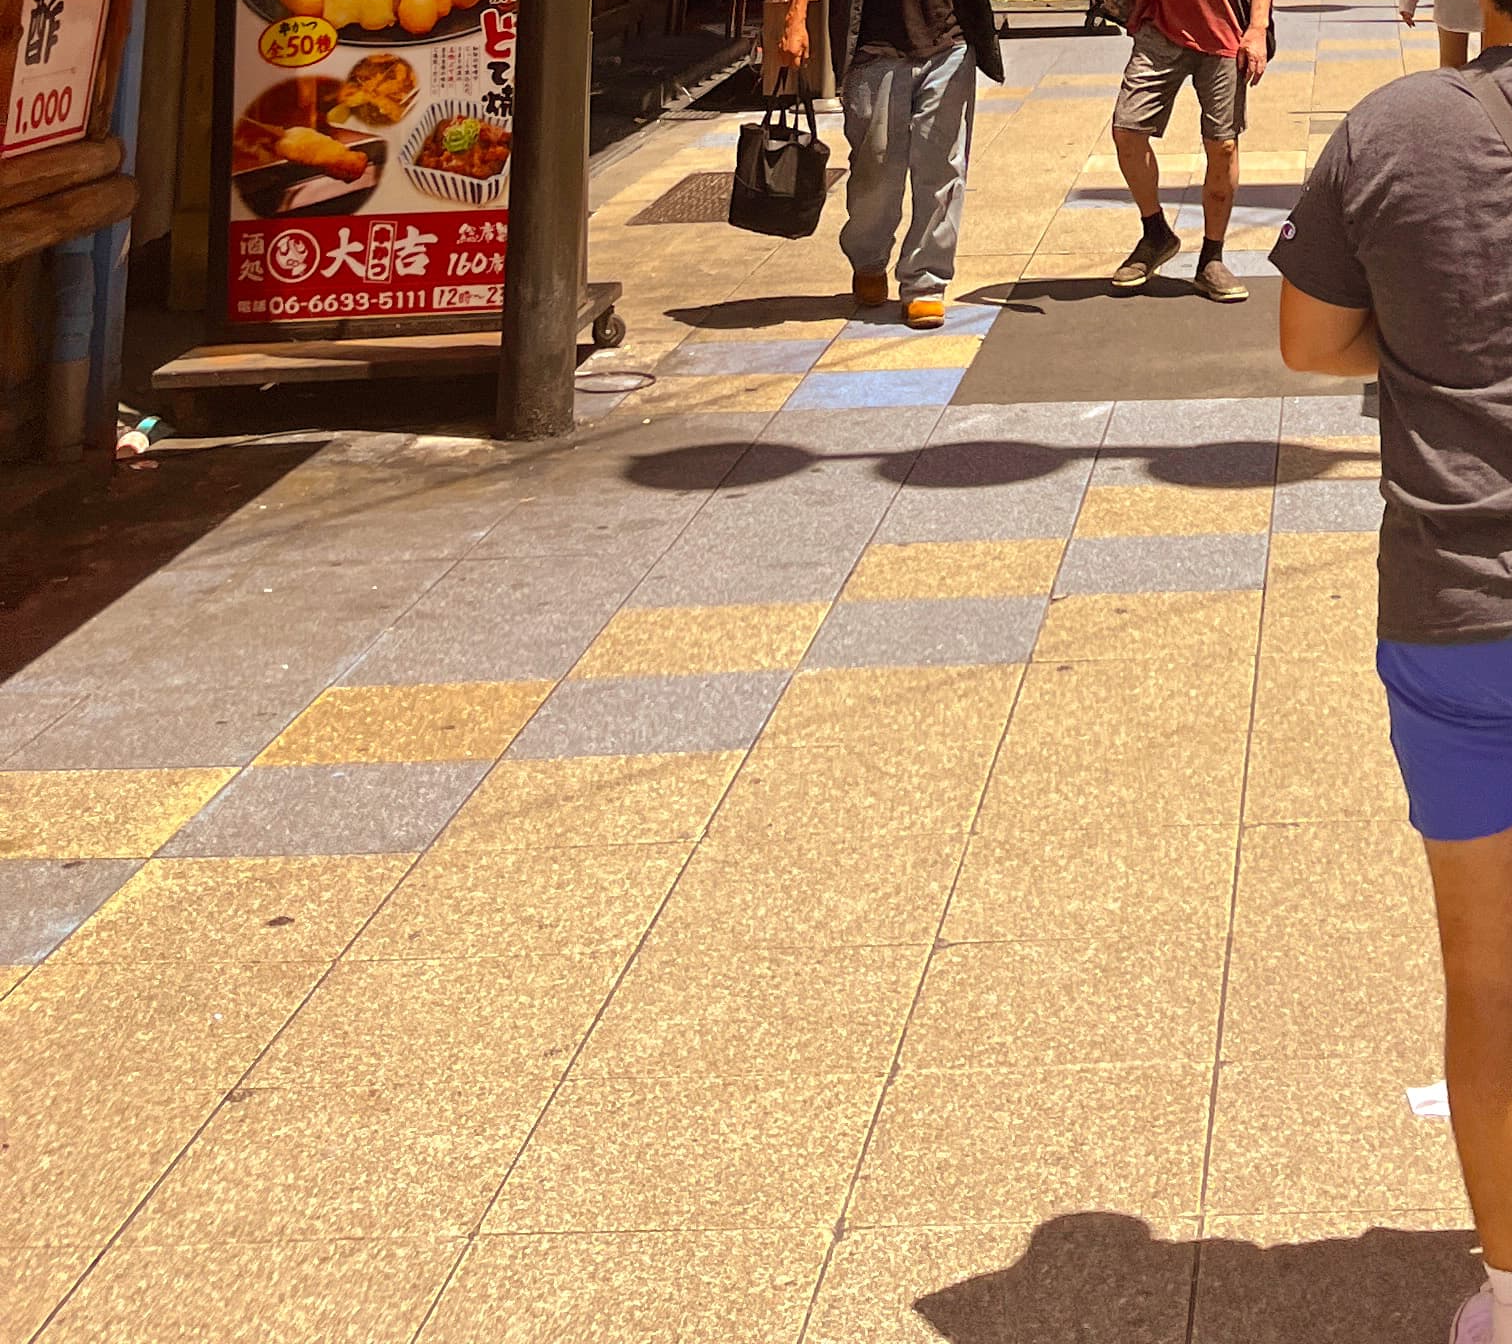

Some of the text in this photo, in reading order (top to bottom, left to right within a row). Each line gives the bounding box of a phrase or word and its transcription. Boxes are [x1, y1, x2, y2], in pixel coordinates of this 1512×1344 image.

[278, 20, 318, 34] 串かつ
[266, 34, 332, 60] 全50種
[15, 85, 73, 135] 1,000
[238, 232, 265, 282] 酒処
[269, 289, 427, 315] 06-6633-5111
